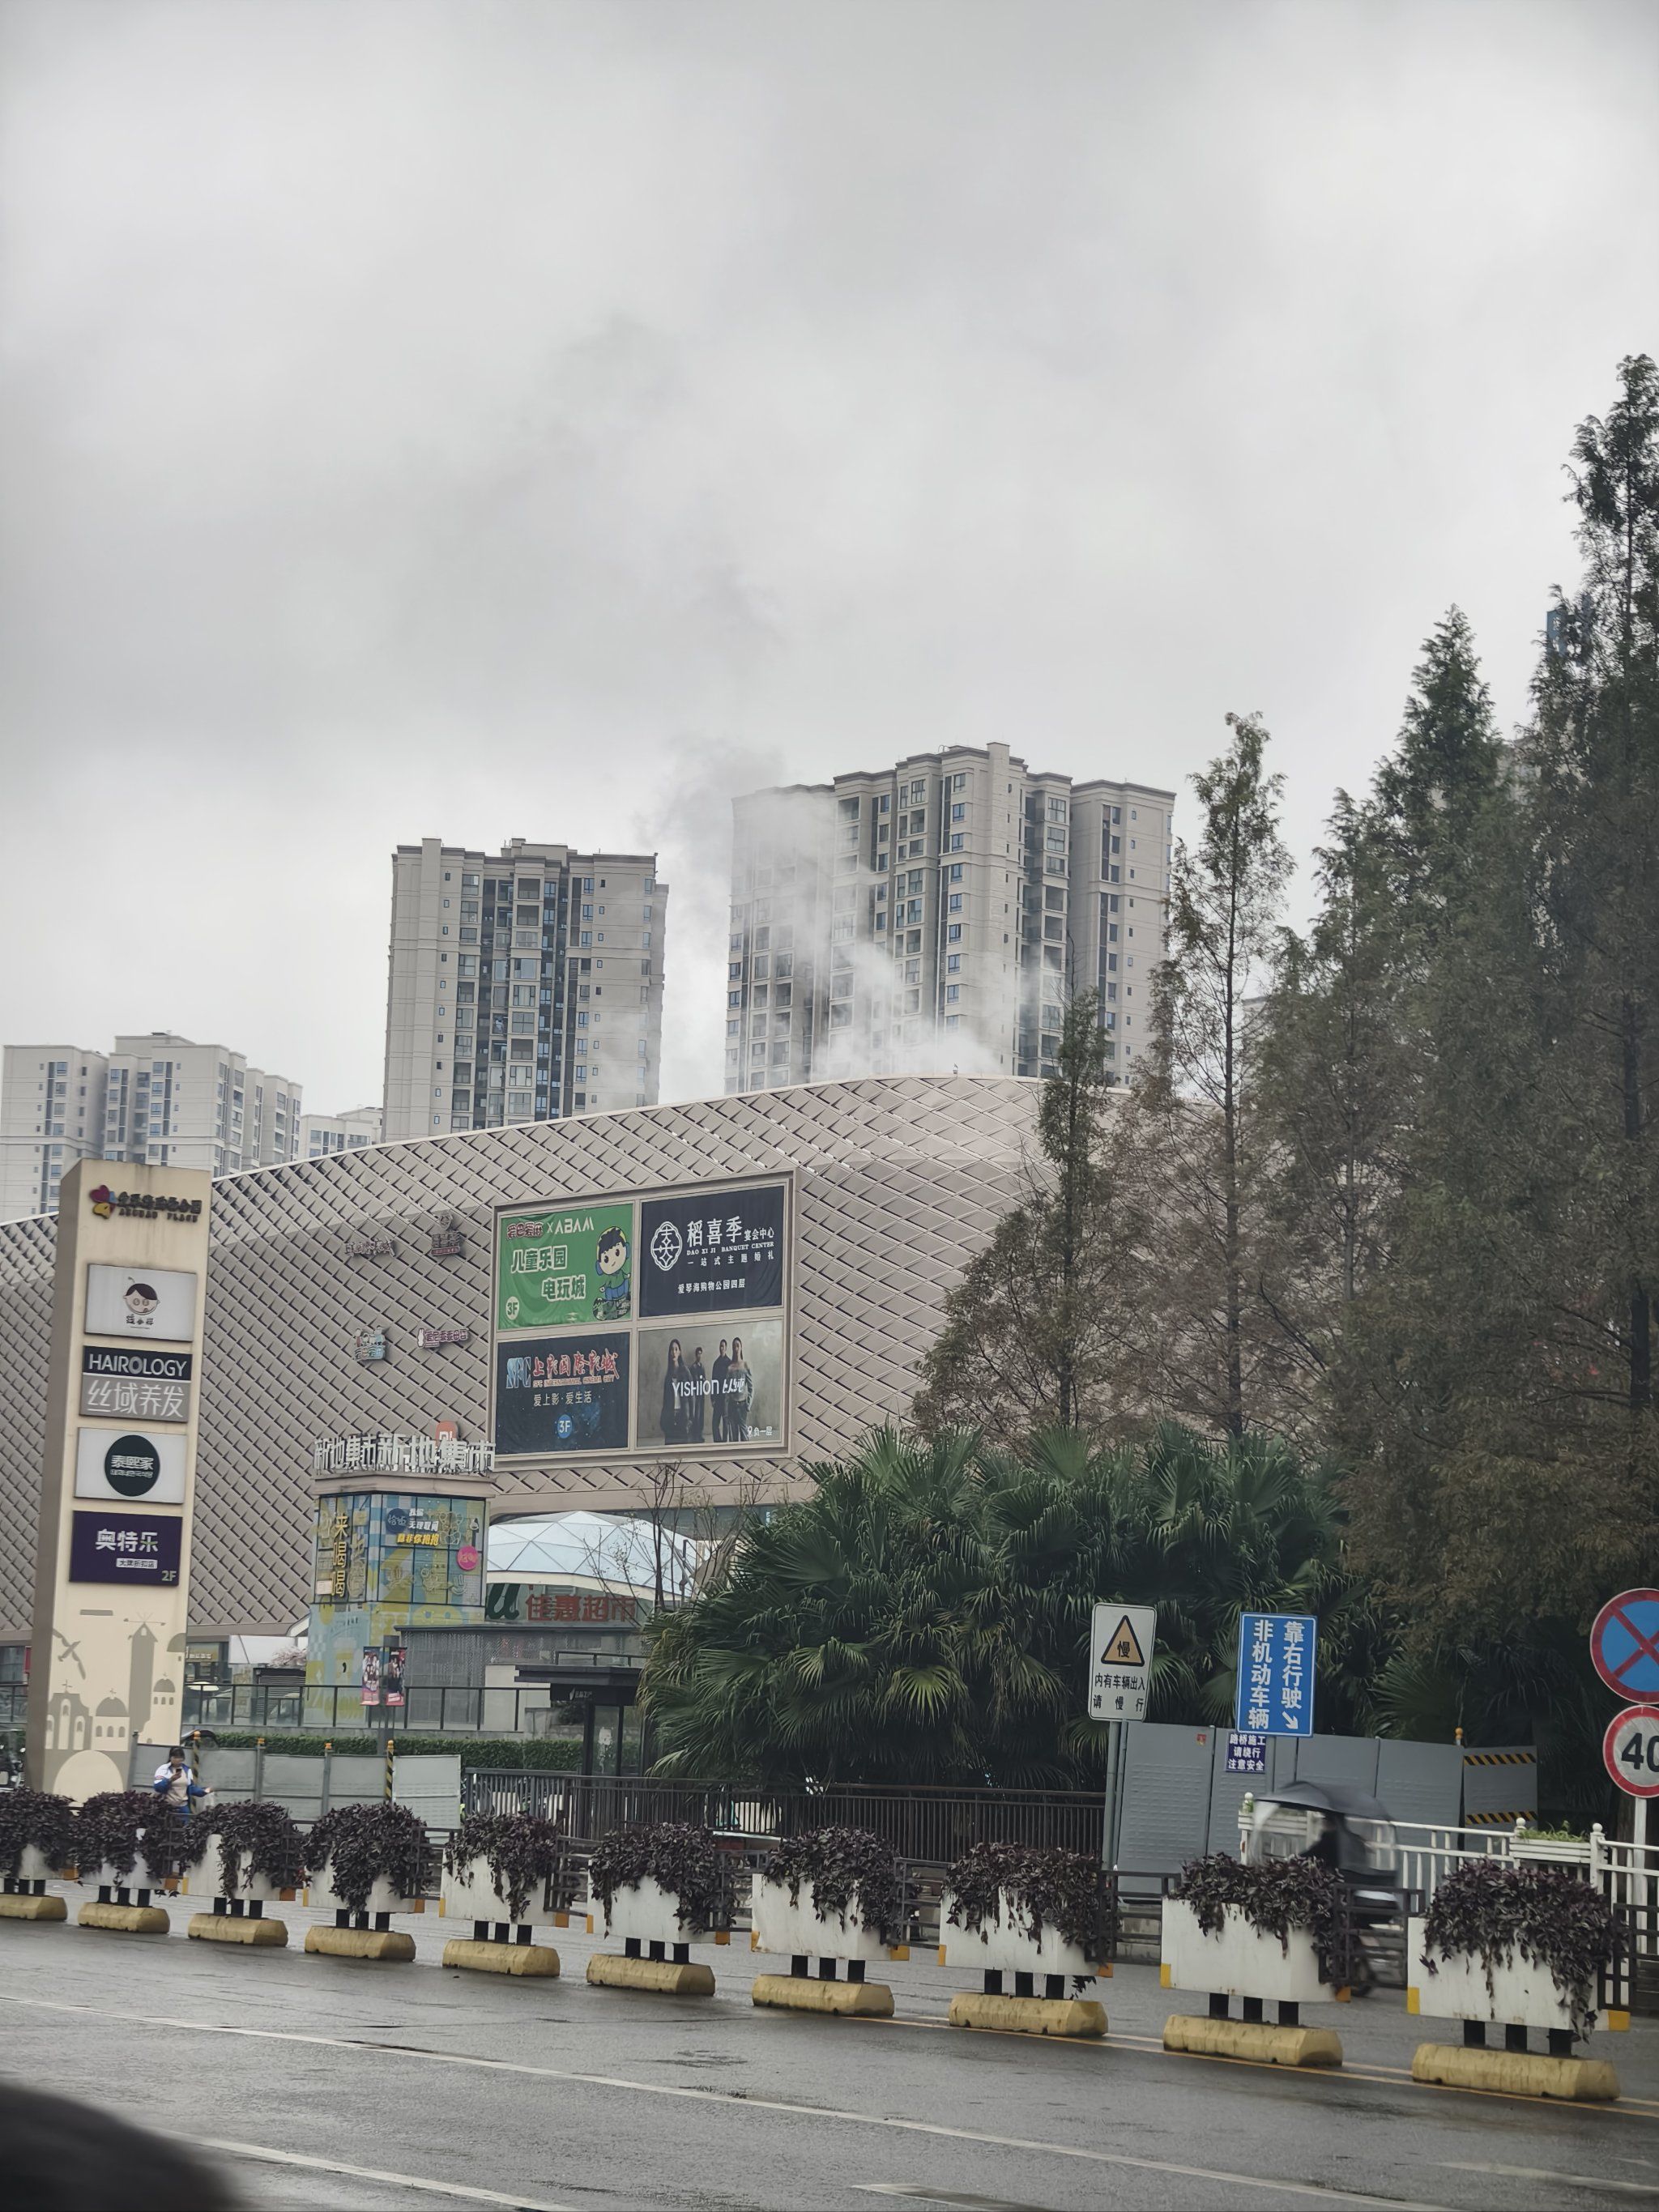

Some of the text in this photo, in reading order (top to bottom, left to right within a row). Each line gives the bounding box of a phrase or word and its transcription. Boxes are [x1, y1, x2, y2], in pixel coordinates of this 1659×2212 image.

[687, 1216, 774, 1247] 稻喜季 宴会中心
[722, 1244, 749, 1252] BANQUET
[510, 1245, 567, 1274] 儿童乐园
[688, 1251, 774, 1267] 一站式主题婚礼
[541, 1274, 586, 1302] 电玩城
[678, 1278, 746, 1294] 爱琴海购物公园四层
[507, 1302, 518, 1315] 3F
[89, 1353, 187, 1377] HAIROLOGY
[533, 1348, 620, 1379] 上影国际影城
[87, 1379, 185, 1417] 丝域养发
[559, 1420, 570, 1433] 3F
[377, 1433, 496, 1473] 新地集市
[95, 1528, 159, 1552] 奥特乐
[331, 1514, 348, 1597] 来喝喝
[161, 1570, 177, 1581] 2F
[1117, 1640, 1131, 1658] 慢
[1281, 1621, 1304, 1710] 靠右行驶
[1094, 1673, 1145, 1691] 内有车辆出入
[1248, 1620, 1273, 1730] 非机动车辆
[1093, 1694, 1145, 1712] 请慢行
[1229, 1733, 1266, 1746] 路桥施工
[1233, 1746, 1261, 1758] 请绕行
[1227, 1758, 1265, 1771] 注意安全
